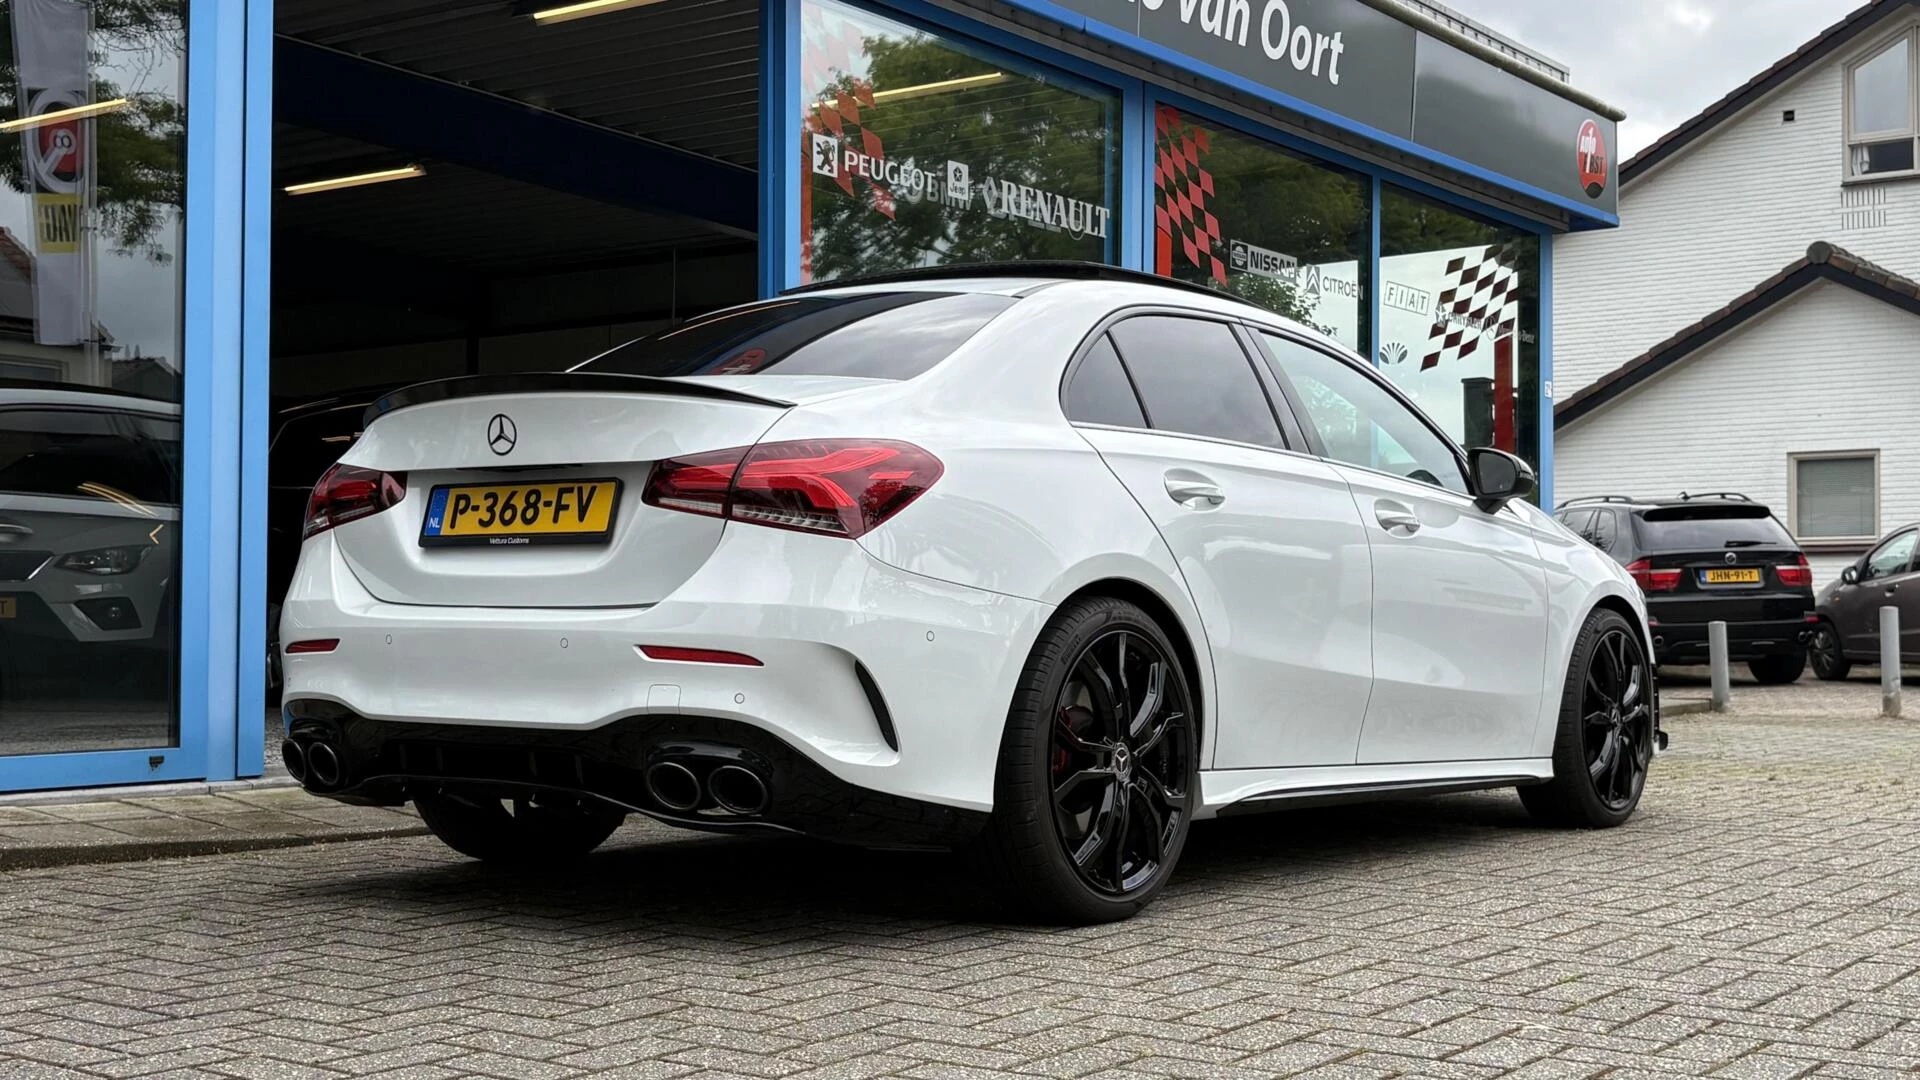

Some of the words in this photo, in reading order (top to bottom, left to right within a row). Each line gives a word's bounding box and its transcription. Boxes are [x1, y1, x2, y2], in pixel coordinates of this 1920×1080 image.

[1261, 0, 1344, 85] Oort
[844, 150, 936, 193] PEUGEOT
[1000, 179, 1110, 239] RENAULT
[1250, 251, 1296, 279] NISSAN
[1322, 276, 1363, 300] CITROËN
[1387, 288, 1427, 312] FIAT
[428, 517, 440, 528] NL
[449, 485, 598, 530] P-368-FV
